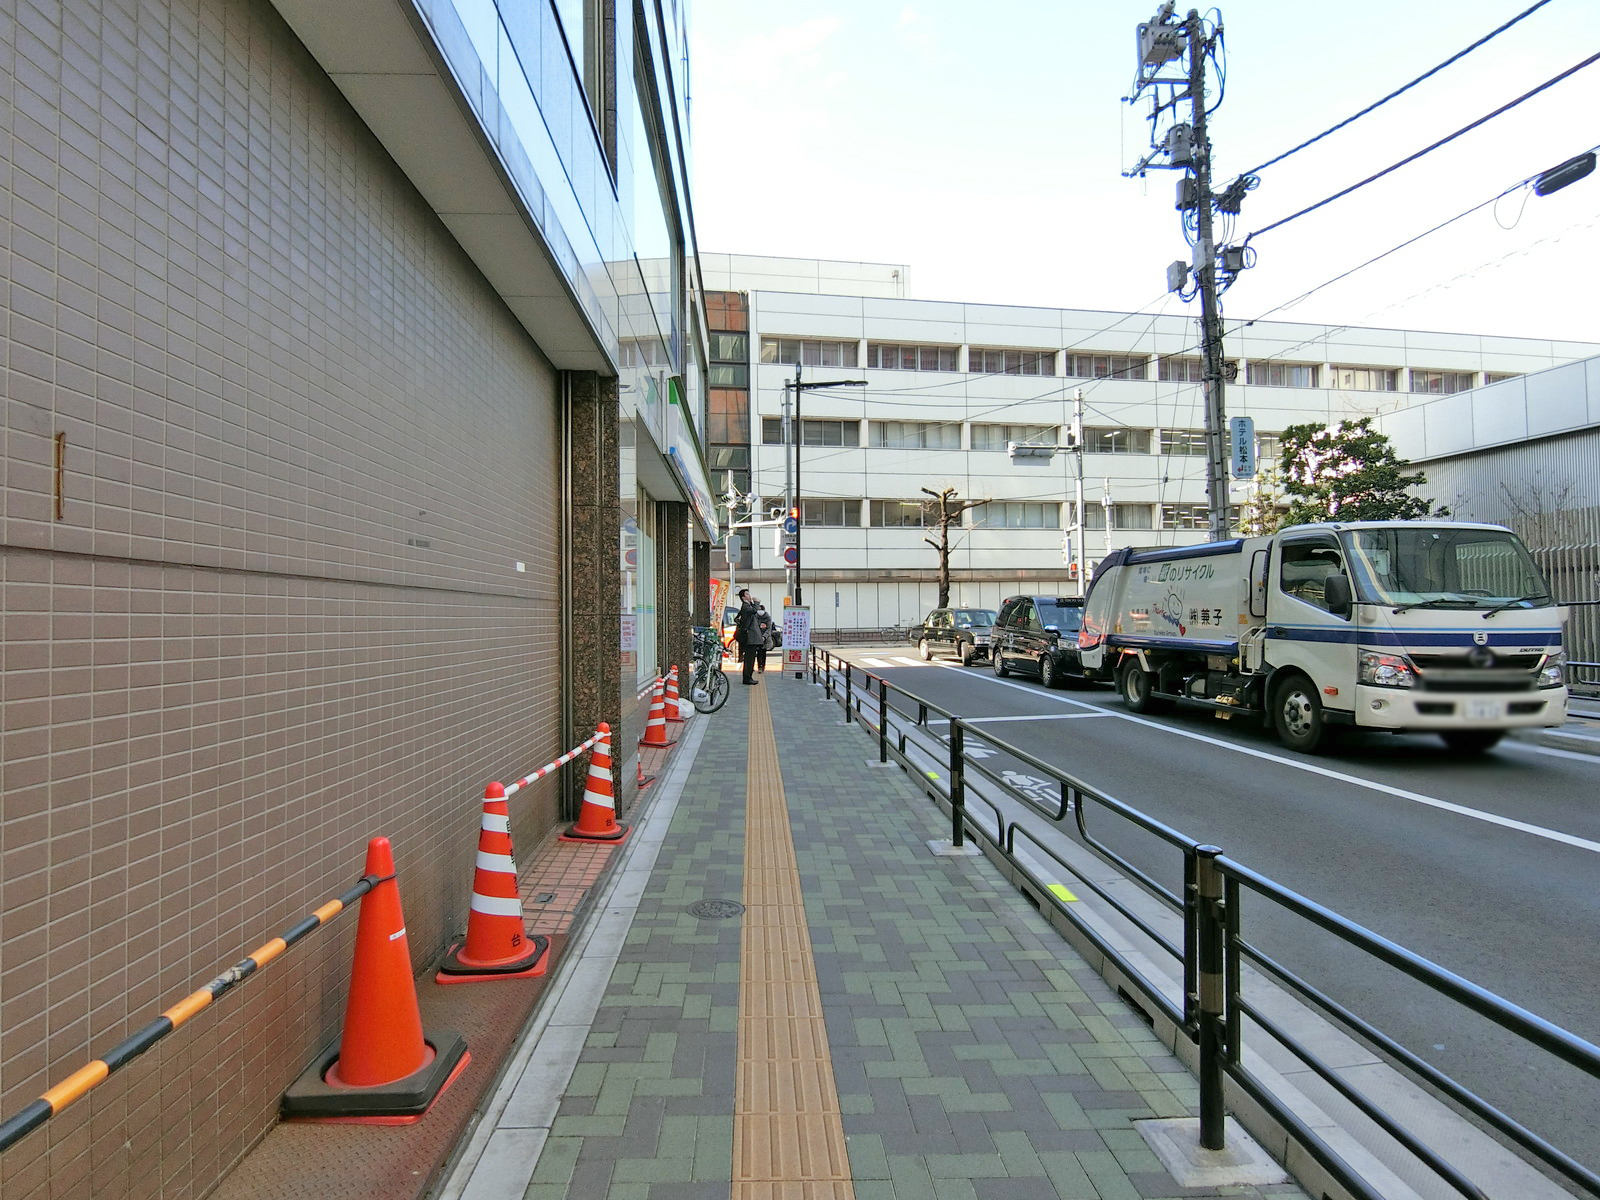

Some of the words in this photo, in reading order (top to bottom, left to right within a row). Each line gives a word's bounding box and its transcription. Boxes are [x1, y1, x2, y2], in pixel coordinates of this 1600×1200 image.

[1238, 419, 1248, 463] ホテル松本
